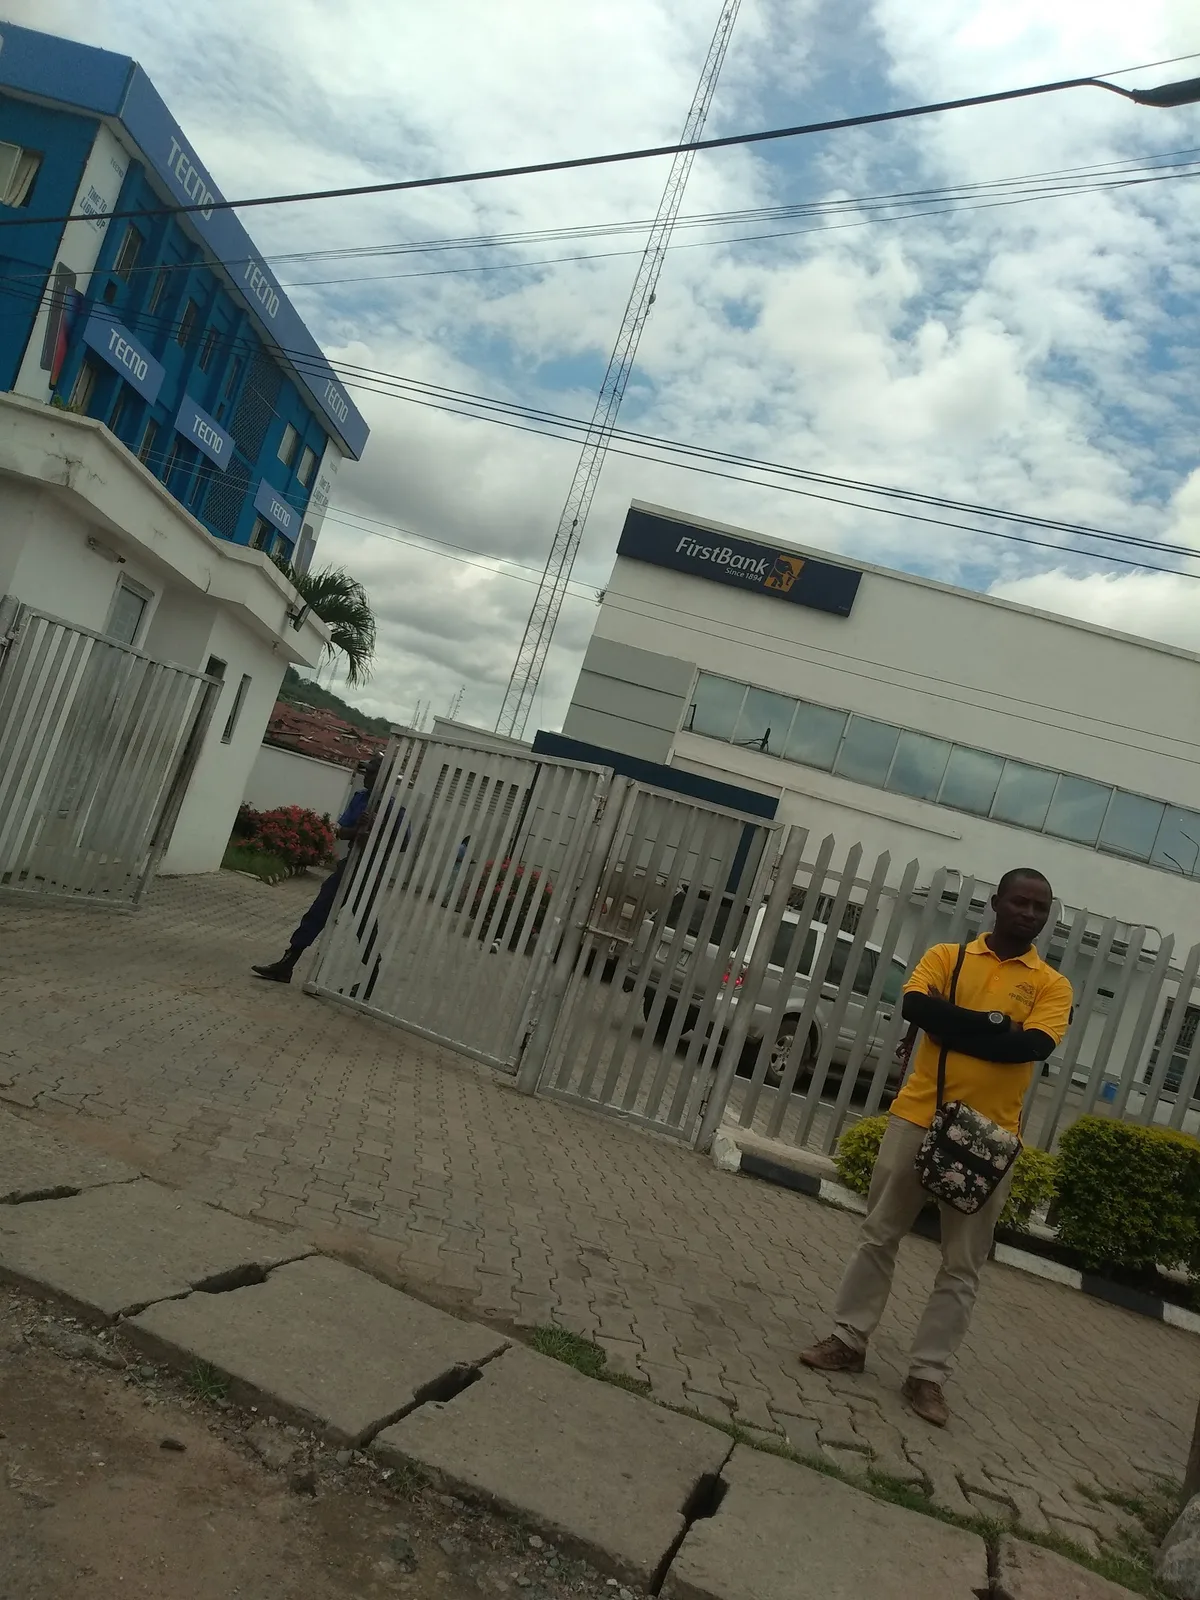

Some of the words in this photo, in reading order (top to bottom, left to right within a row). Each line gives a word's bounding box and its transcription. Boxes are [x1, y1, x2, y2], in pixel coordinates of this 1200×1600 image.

[167, 135, 215, 221] TECNO
[80, 197, 99, 219] LIGH
[87, 184, 101, 206] TIME
[98, 198, 107, 213] TO
[244, 254, 280, 319] TECNO
[108, 328, 148, 381] TECNO
[324, 378, 349, 423] TECNO
[192, 414, 224, 454] TECNO
[269, 497, 291, 527] TECNO
[675, 536, 770, 575] FirstBank
[724, 567, 745, 578] Since
[745, 572, 763, 582] 1894
